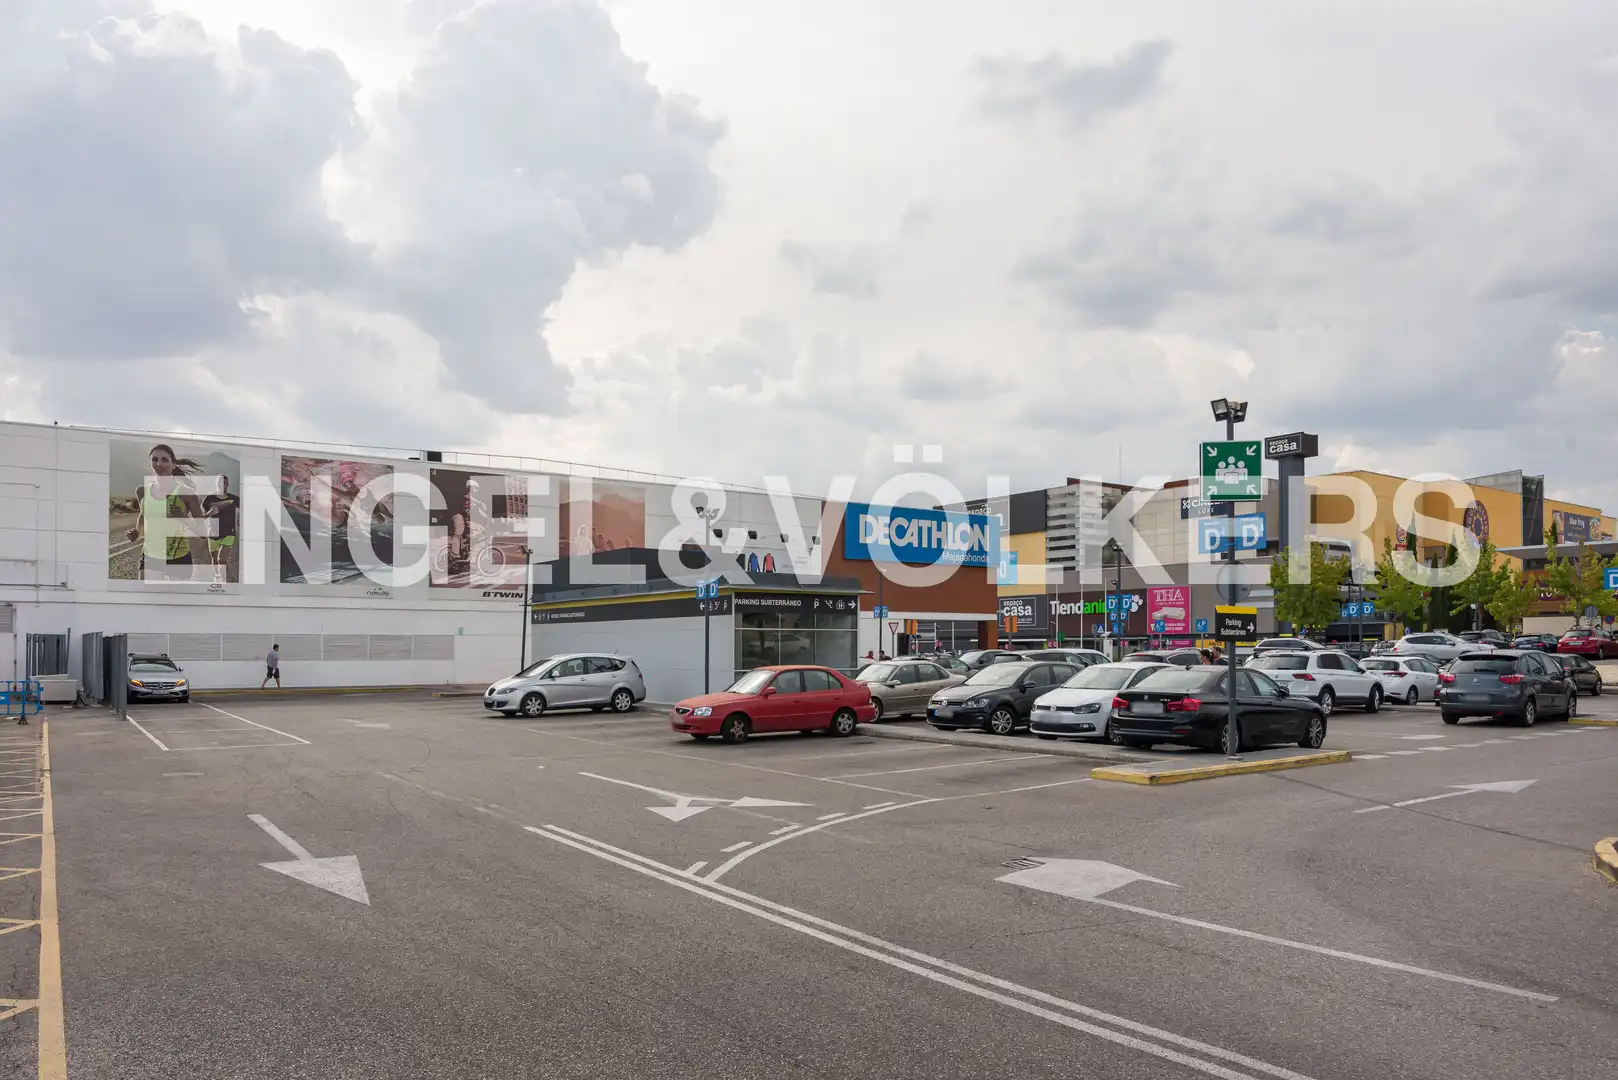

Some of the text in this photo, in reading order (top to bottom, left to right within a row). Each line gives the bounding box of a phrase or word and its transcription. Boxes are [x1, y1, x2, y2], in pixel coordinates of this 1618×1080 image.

[1269, 442, 1297, 454] casa
[859, 513, 990, 552] DECATHLON
[1153, 588, 1185, 602] THA
[734, 598, 760, 606] PARKING
[1003, 600, 1023, 608] espaço
[1003, 605, 1033, 616] casa
[1225, 618, 1242, 628] Parking
